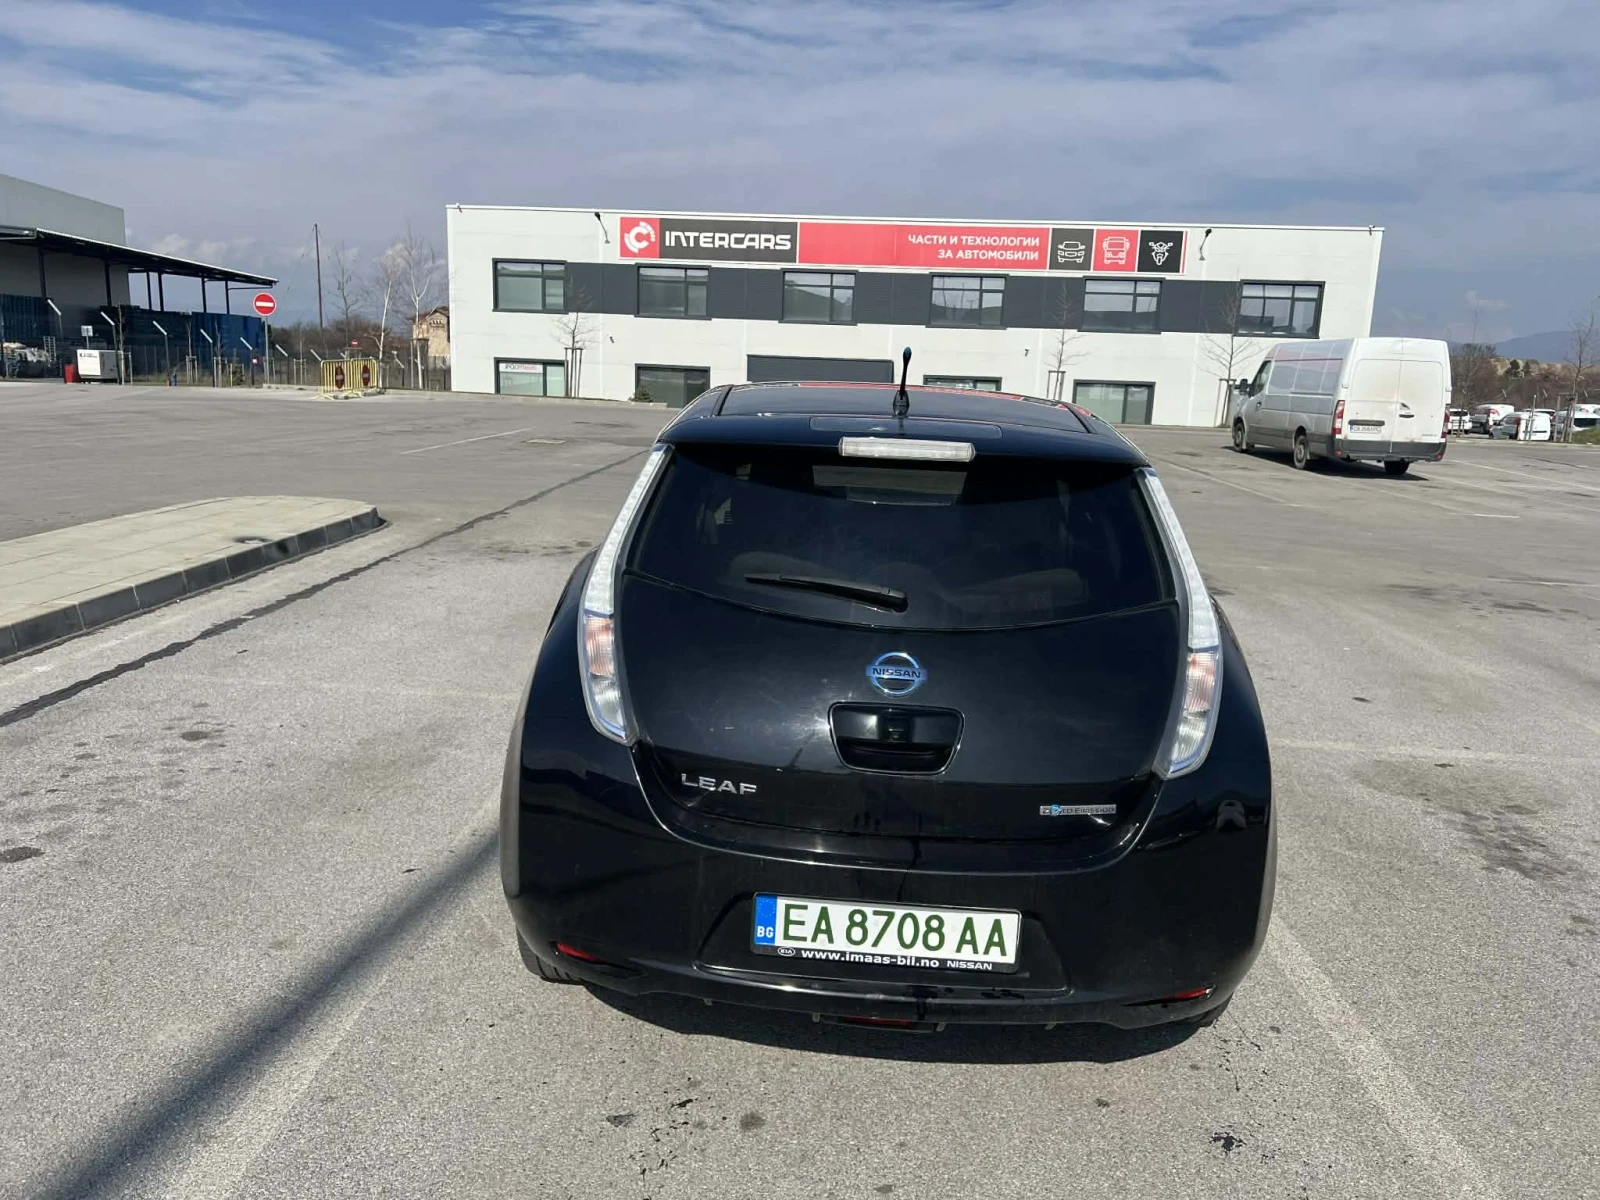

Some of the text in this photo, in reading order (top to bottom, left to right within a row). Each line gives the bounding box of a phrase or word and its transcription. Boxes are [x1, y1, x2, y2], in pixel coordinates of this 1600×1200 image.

[665, 231, 792, 250] INTERCARS
[908, 234, 1040, 247] ЧАСТИ И ТЕХНОЛОГИИ
[937, 249, 1039, 261] ЗА АВТОМОБИЛИ
[872, 668, 920, 678] NISSAN
[681, 773, 757, 795] LEAF
[756, 925, 774, 938] BG
[783, 903, 1007, 957] EA 8708 AA
[801, 949, 940, 968] www.imaas-bil.no
[946, 960, 993, 971] NISSAN
